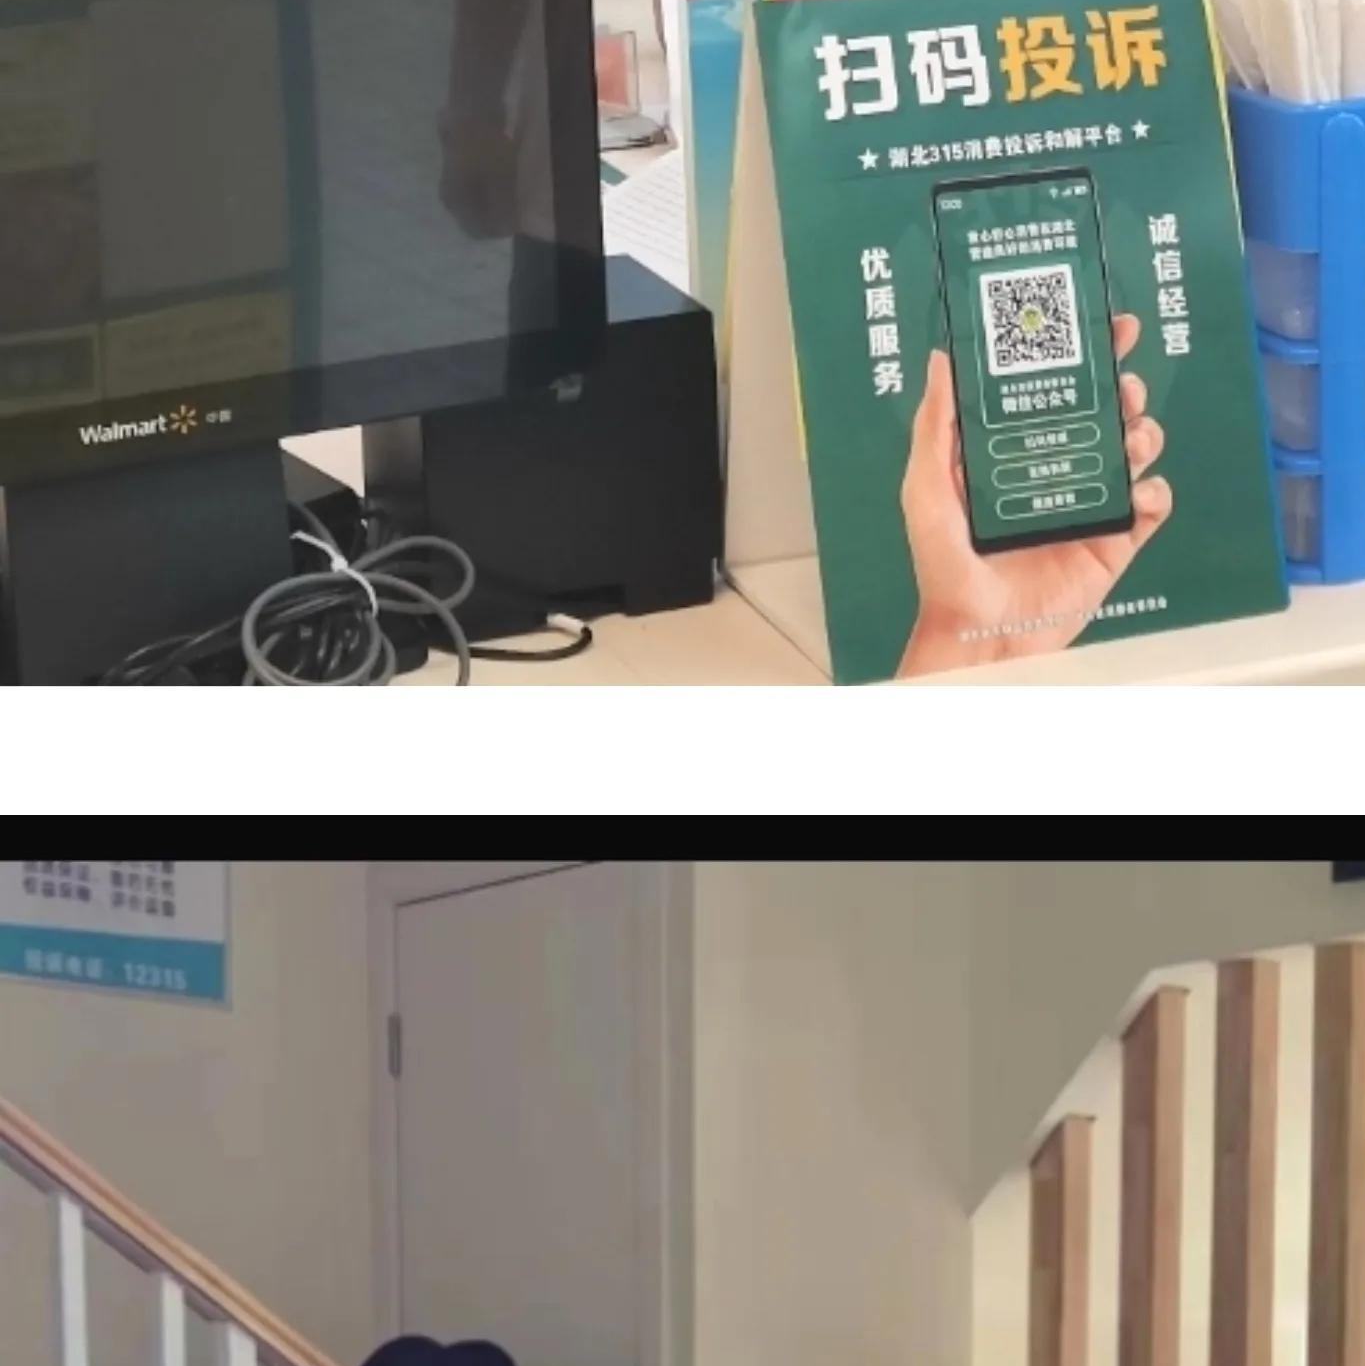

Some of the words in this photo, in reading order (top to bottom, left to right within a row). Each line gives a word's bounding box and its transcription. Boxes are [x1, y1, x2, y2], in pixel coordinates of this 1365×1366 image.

[814, 5, 1167, 121] 扫码投诉
[861, 247, 903, 395] 优质服务
[1148, 213, 1190, 356] 诚信经营
[79, 414, 167, 444] Walmart
